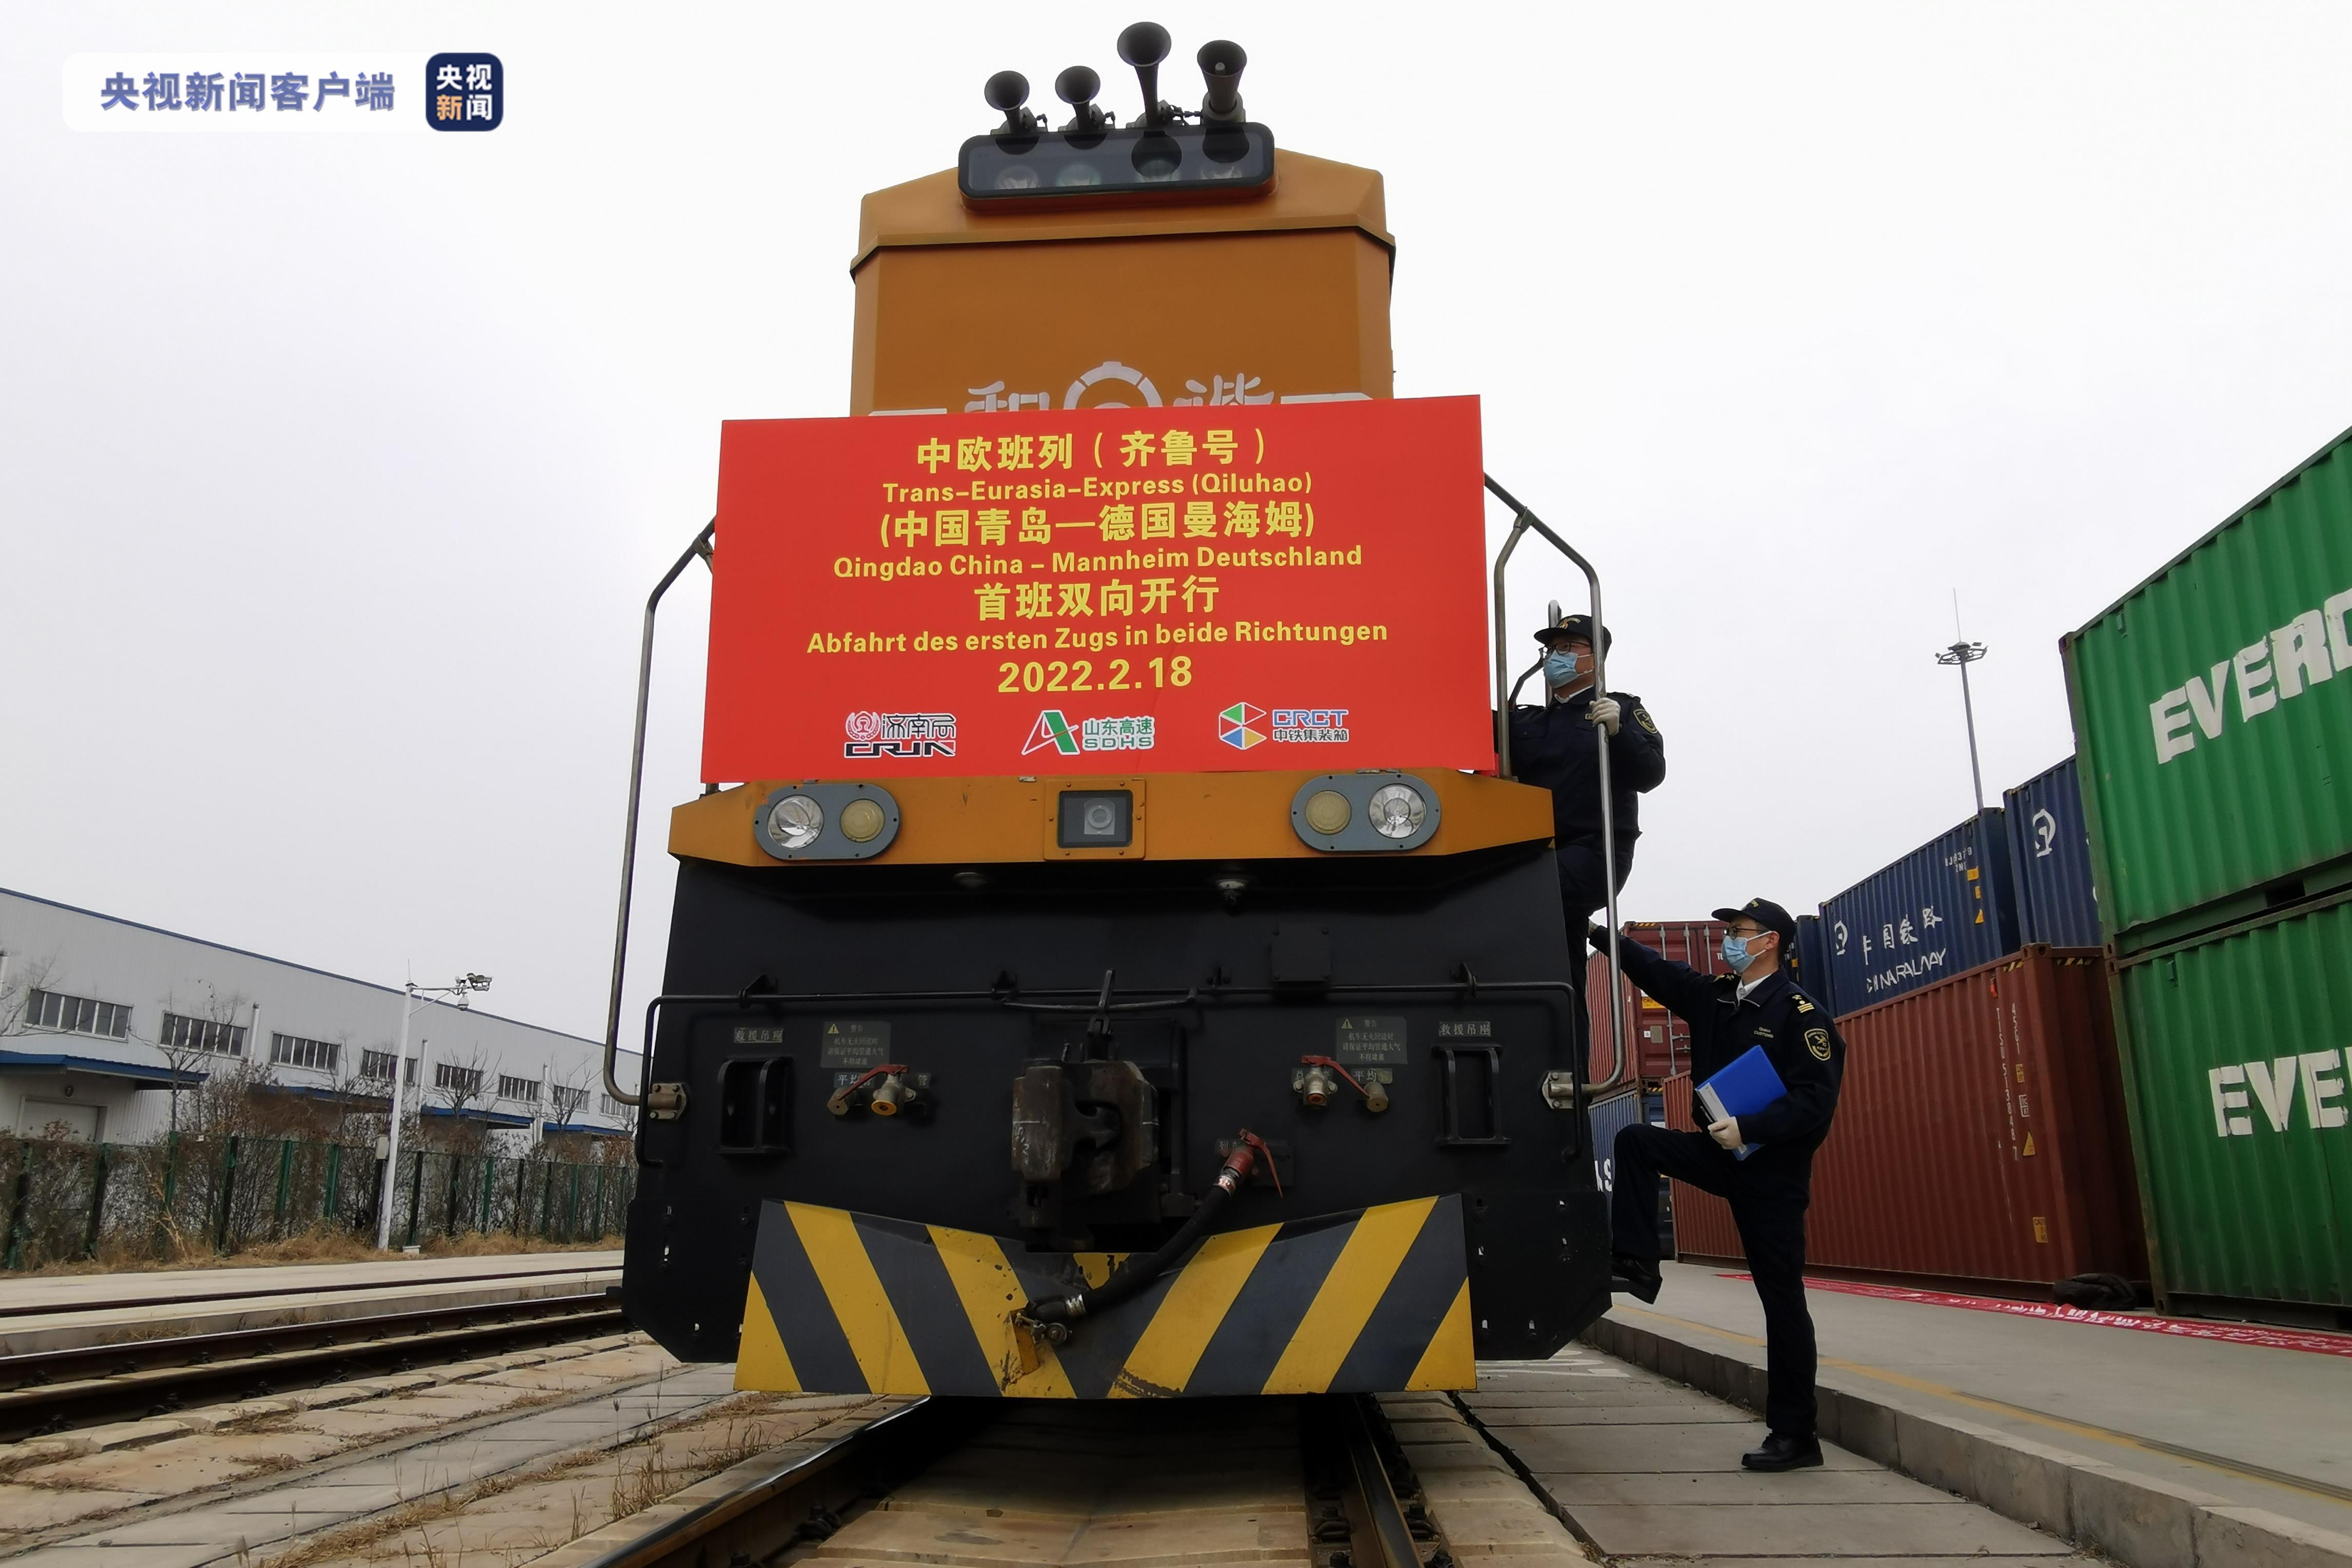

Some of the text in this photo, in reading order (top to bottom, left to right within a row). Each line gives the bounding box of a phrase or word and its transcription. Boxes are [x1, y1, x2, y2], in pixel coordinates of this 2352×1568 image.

[1192, 471, 1312, 495] (Qiluhao)
[834, 556, 942, 581] Qingdao
[950, 554, 1022, 575] China
[1052, 547, 1189, 573] Mannheim
[1197, 545, 1361, 567] Deutschland
[974, 575, 1219, 621] 首班双向开行
[807, 621, 1387, 653] Abfahrt des ersten Zugs in beide Richtungen
[998, 656, 1192, 693] 2022.2.18
[882, 714, 955, 738] 济南局
[1085, 718, 1152, 735] 山东高速
[1274, 711, 1348, 725] CRCT
[1084, 736, 1152, 748] SDHS
[1274, 729, 1348, 741] 中铁集装箱
[735, 1029, 783, 1042] 救援吊座
[1440, 1023, 1490, 1036] 救援吊座
[2209, 1046, 2352, 1138] EVE
